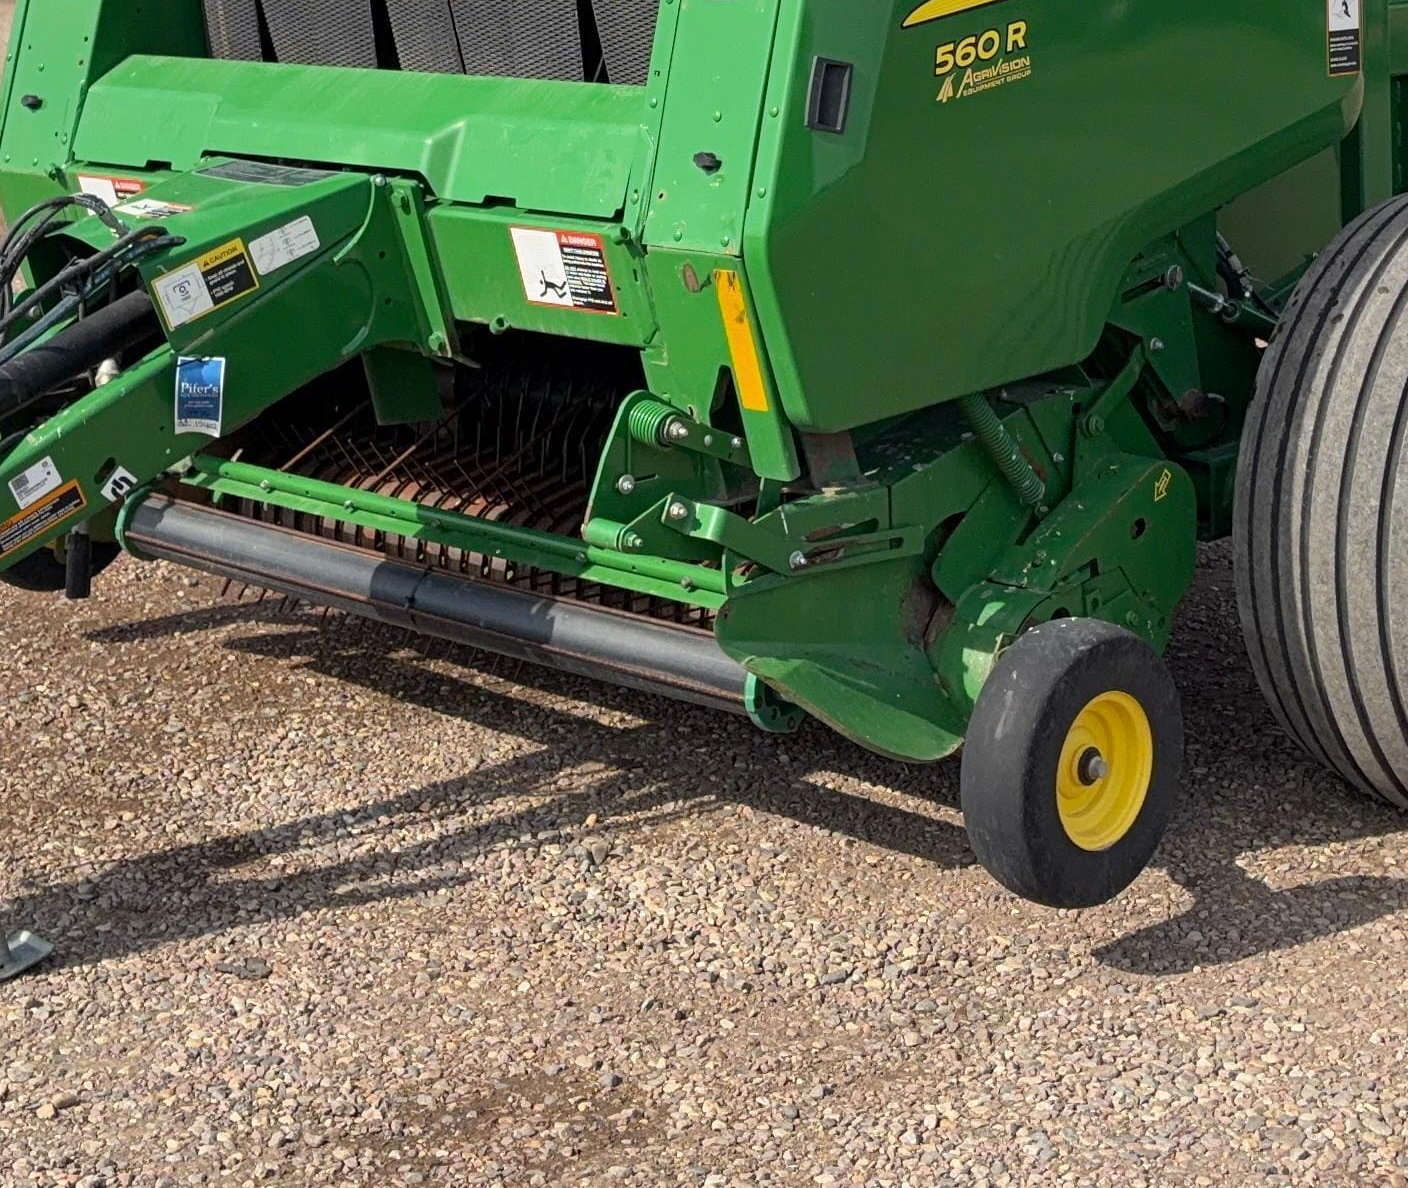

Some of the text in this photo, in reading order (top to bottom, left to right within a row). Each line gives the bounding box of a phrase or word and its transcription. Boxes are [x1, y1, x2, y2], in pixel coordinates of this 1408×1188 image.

[934, 19, 1027, 76] 560 R
[1006, 69, 1032, 83] GROUP
[567, 235, 597, 247] DANGER
[209, 245, 238, 264] CAUTION
[180, 382, 219, 394] Pifer's
